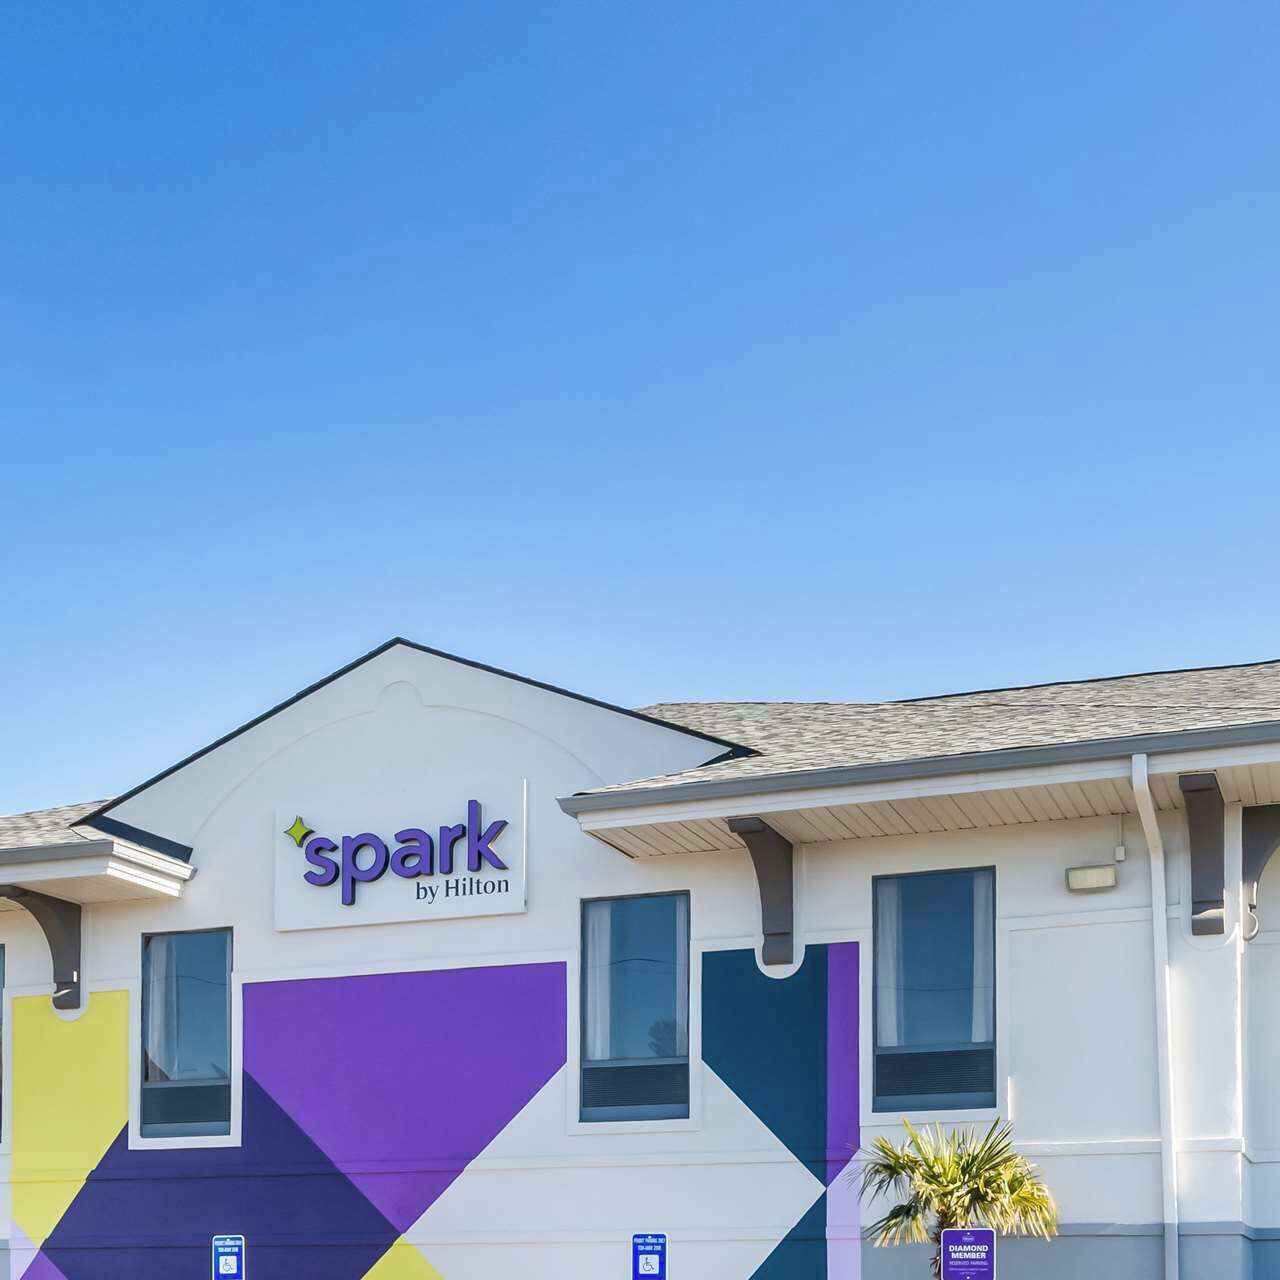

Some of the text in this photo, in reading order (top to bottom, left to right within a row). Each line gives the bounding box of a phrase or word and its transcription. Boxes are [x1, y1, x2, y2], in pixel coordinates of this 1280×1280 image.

[303, 799, 509, 906] spark
[416, 876, 509, 904] by Hilton
